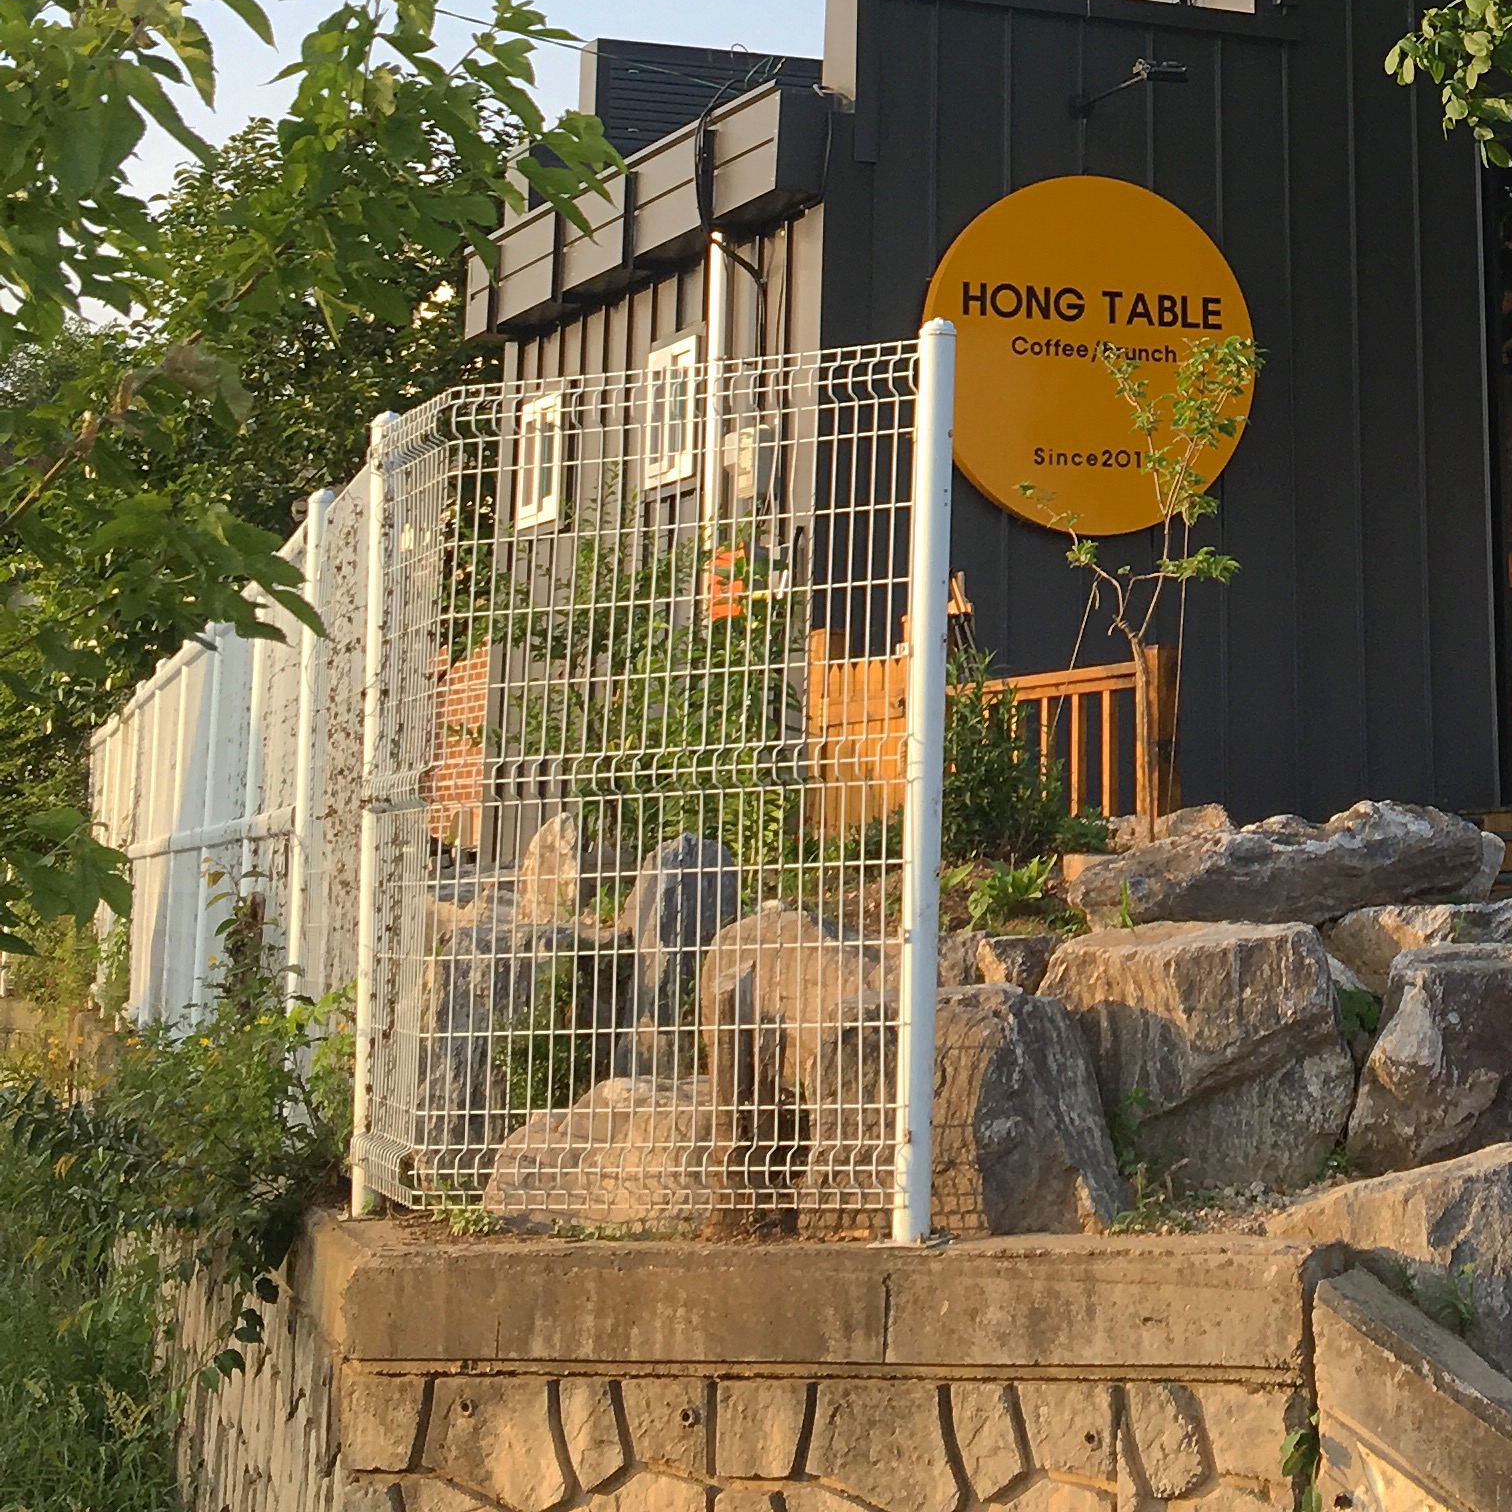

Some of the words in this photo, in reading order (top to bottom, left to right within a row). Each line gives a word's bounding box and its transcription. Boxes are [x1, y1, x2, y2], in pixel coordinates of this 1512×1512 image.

[962, 281, 1086, 323] HONG
[1101, 290, 1223, 330] TABLE
[1033, 446, 1147, 469] Since201
